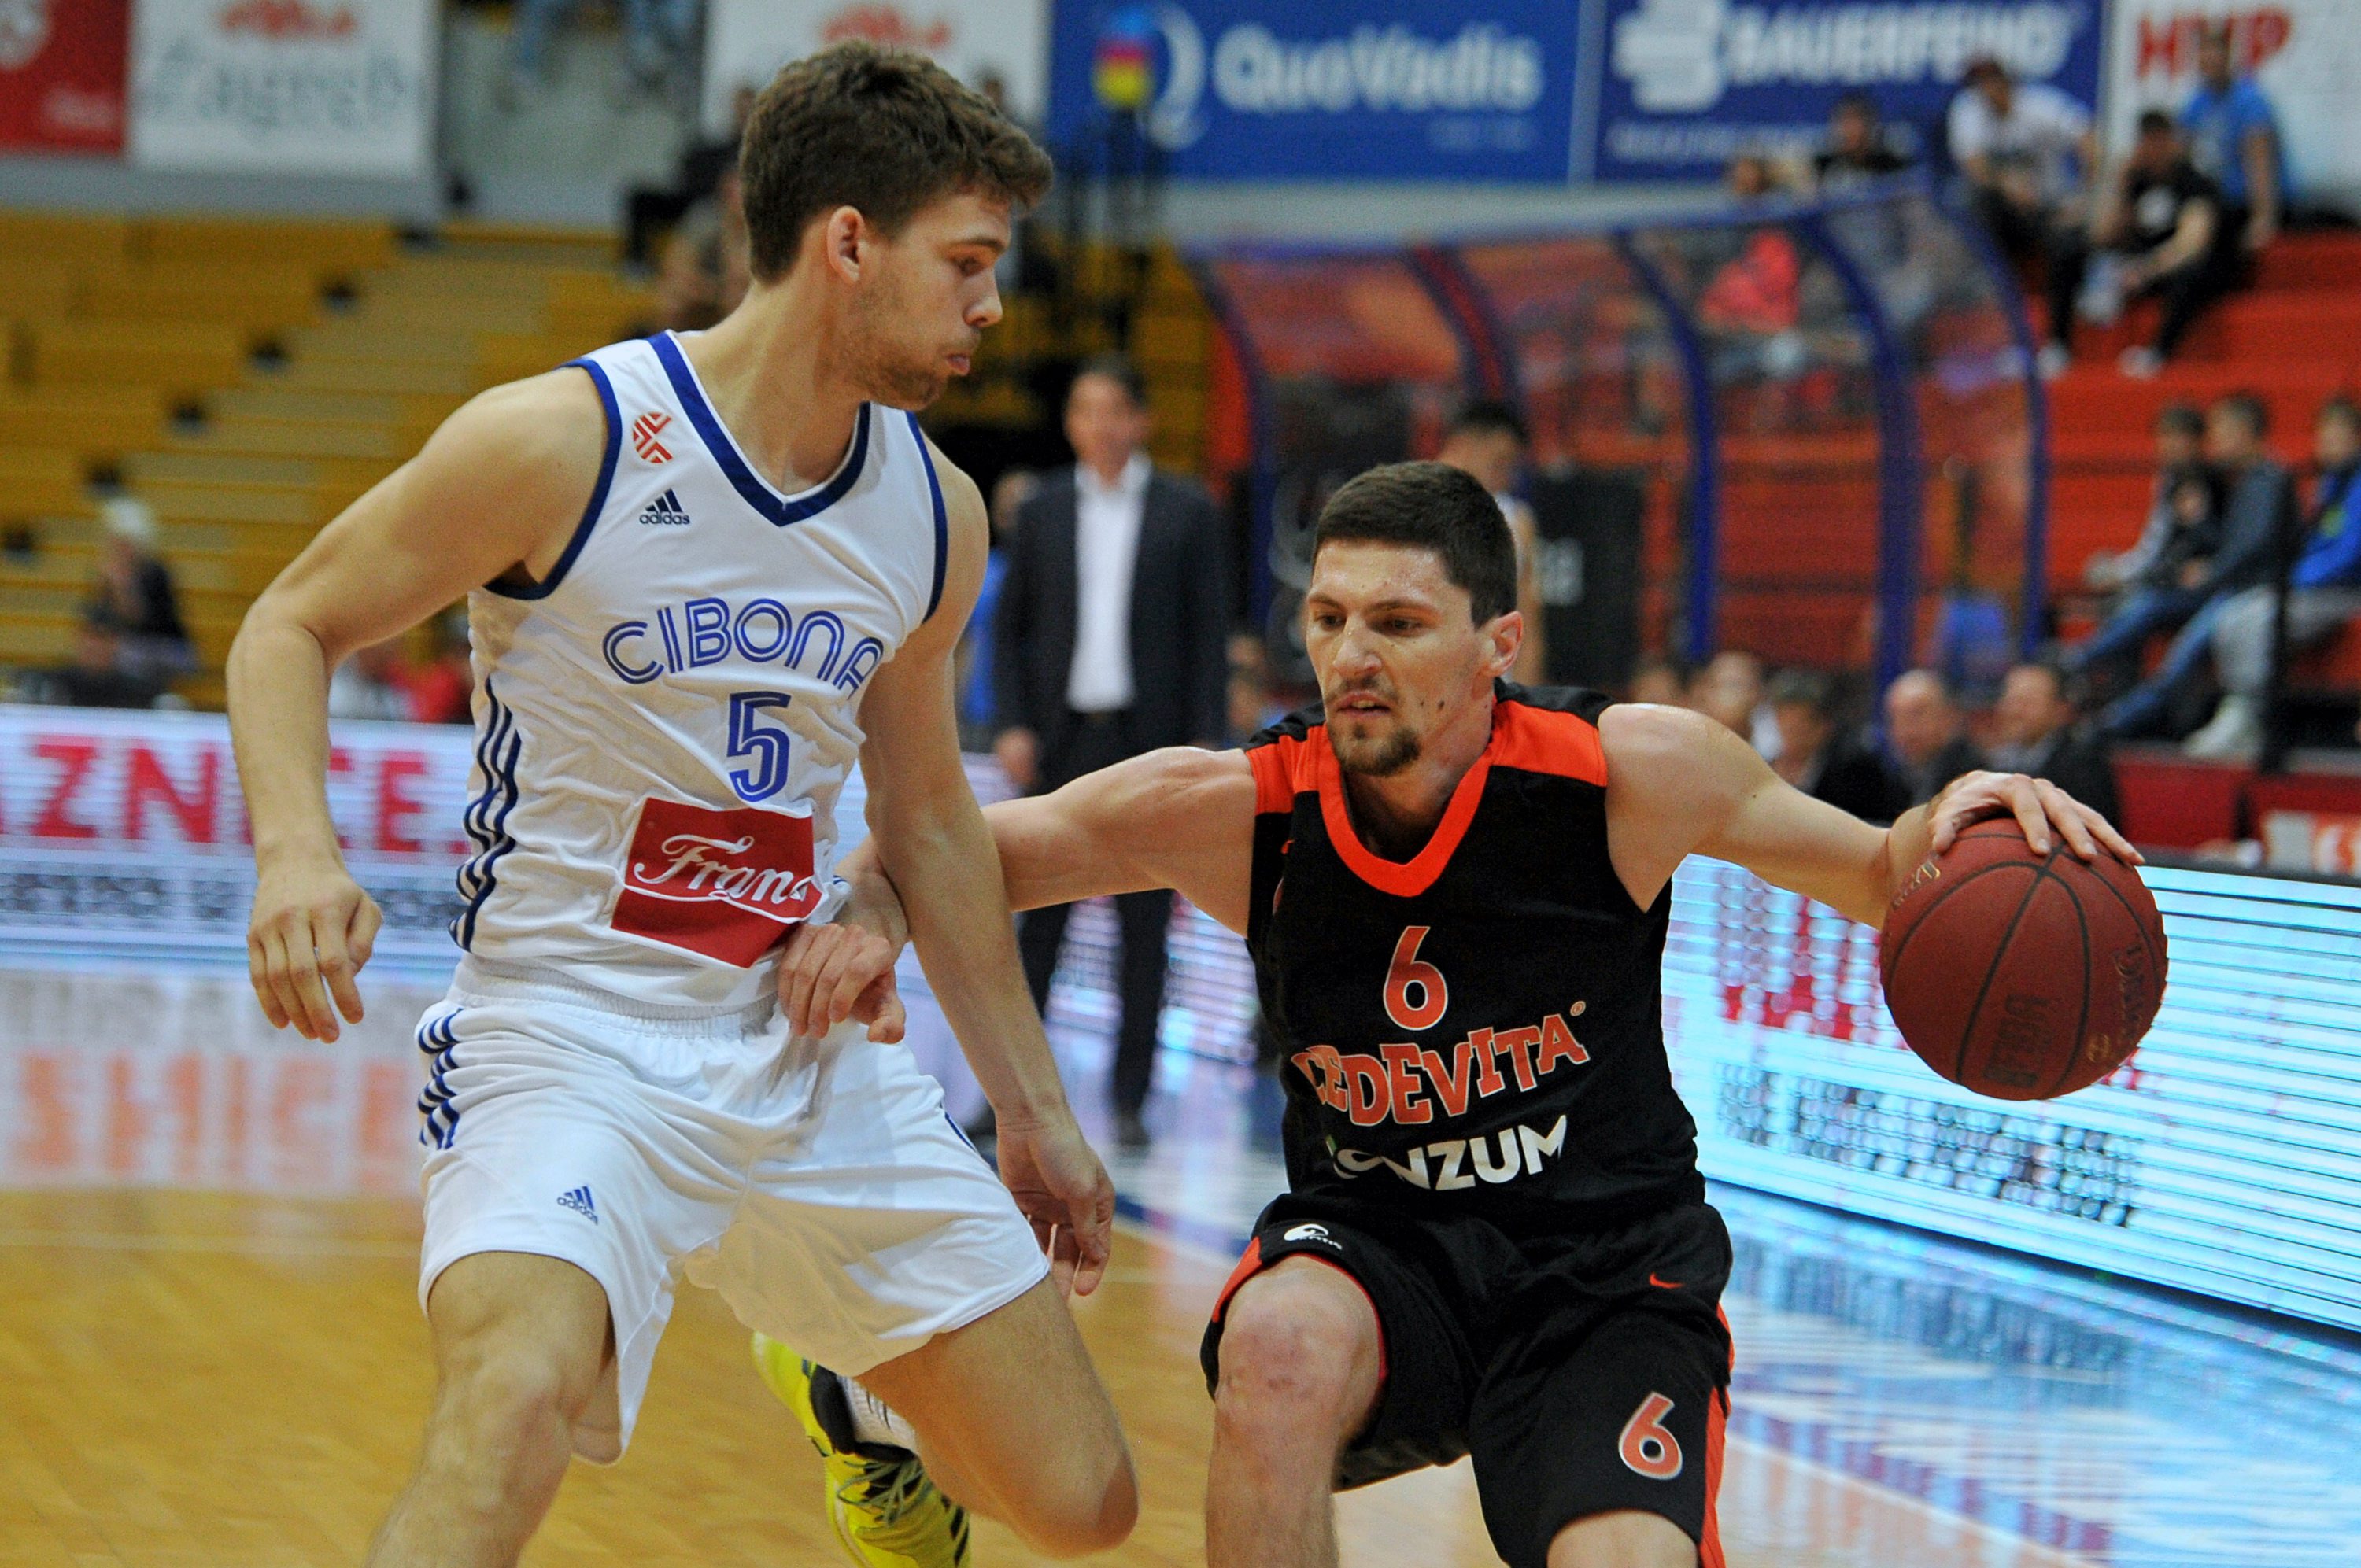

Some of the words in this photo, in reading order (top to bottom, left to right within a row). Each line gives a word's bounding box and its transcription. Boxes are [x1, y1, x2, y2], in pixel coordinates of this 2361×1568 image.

[1212, 21, 1545, 114] QuoVadis
[639, 511, 691, 525] adidas
[602, 596, 885, 700] CIBONA
[726, 691, 792, 802] 5
[1383, 925, 1448, 1031] 6
[1325, 1114, 1567, 1191] ONZUM
[1618, 1391, 1683, 1480] 6
